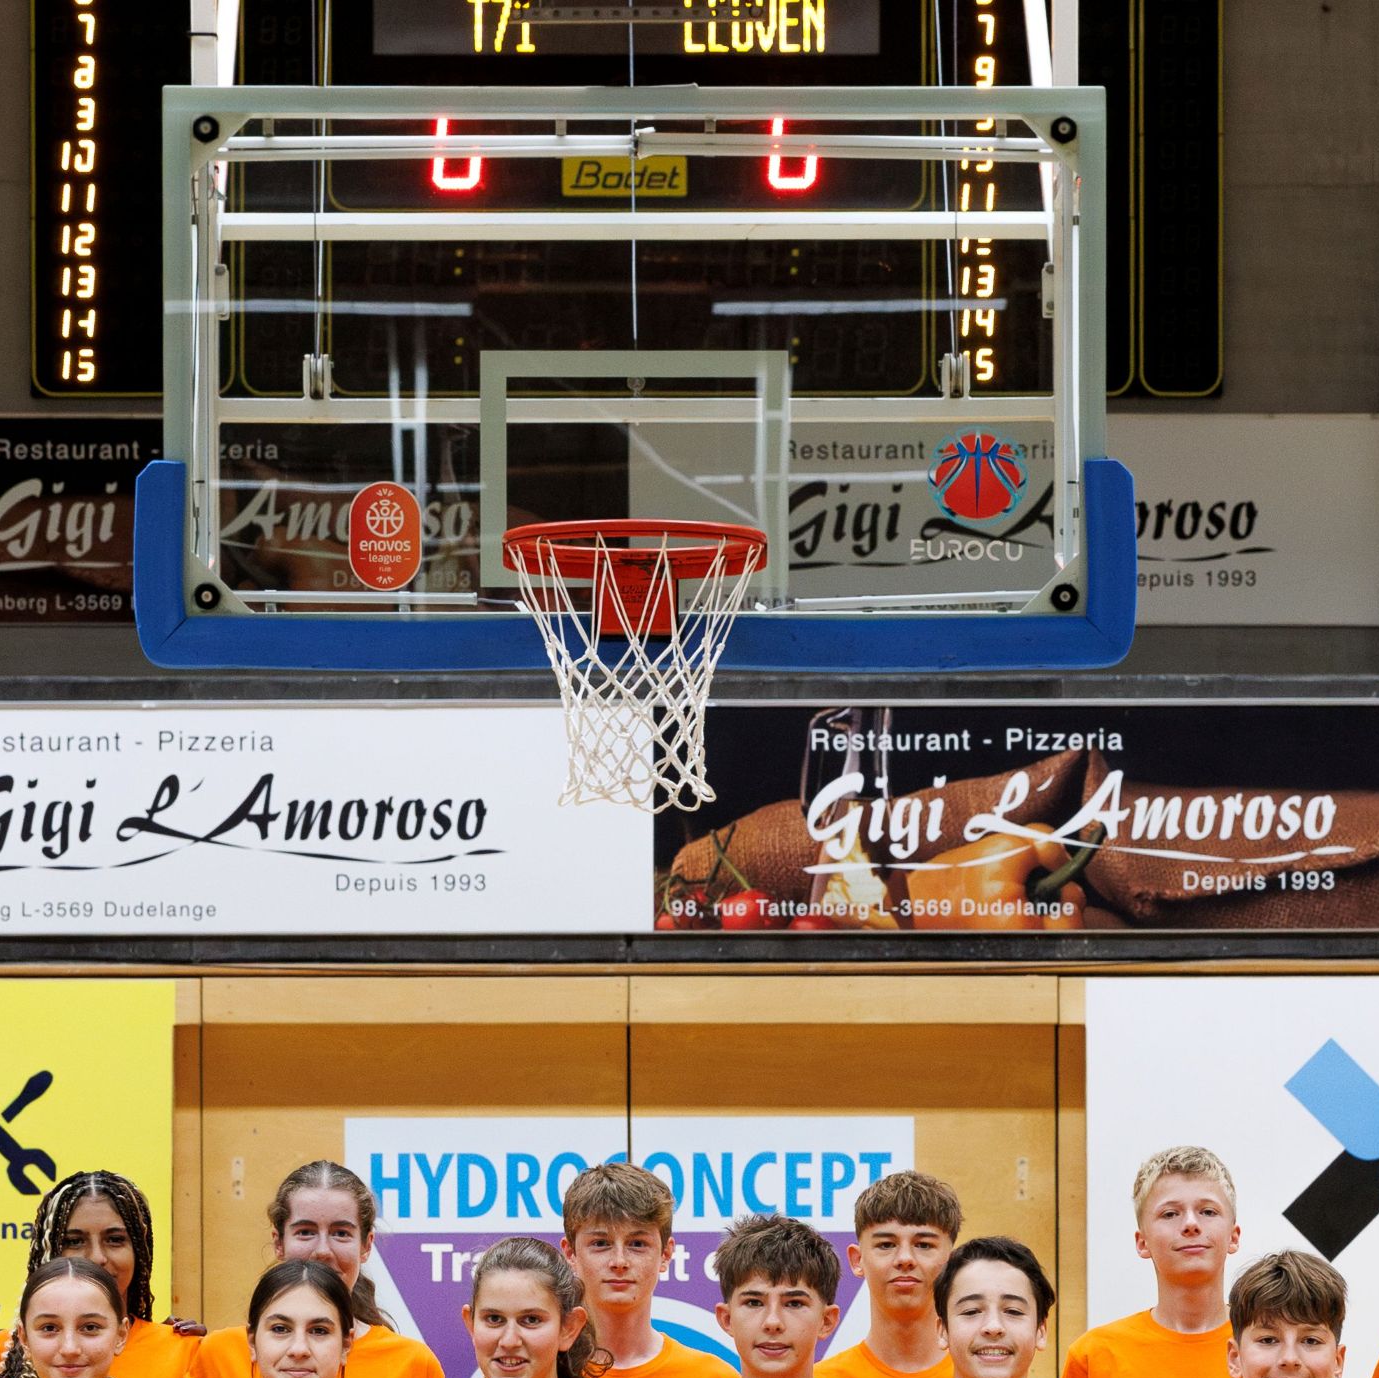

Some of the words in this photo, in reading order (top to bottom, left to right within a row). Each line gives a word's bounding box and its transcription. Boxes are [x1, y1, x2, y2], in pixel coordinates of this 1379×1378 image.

[978, 13, 995, 46] 7
[570, 158, 680, 190] Bodet
[61, 182, 96, 212] 11
[961, 182, 995, 211] 11
[61, 222, 96, 256] 12
[61, 264, 96, 299] 13
[961, 263, 995, 298] 13
[961, 307, 995, 338] 14
[61, 348, 96, 382] 15
[788, 481, 903, 558] Gigi
[359, 539, 412, 553] enovos
[368, 553, 403, 565] league
[910, 538, 1024, 562] EUROCU
[1206, 570, 1257, 588] 1993
[55, 595, 123, 611] L-3569
[158, 731, 275, 753] Pizzeria
[810, 728, 971, 752] Restaurant
[1005, 728, 1124, 752] Pizzeria
[805, 772, 945, 861] Gigi
[335, 874, 418, 895] Depuis
[430, 874, 488, 893] 1993
[1182, 870, 1266, 893] Depuis
[1276, 870, 1336, 890] 1993
[21, 901, 95, 919] L-3569
[103, 900, 218, 923] Dudelange
[670, 898, 706, 920] 98,
[712, 903, 748, 917] rue
[755, 897, 870, 921] Tattenberg
[878, 897, 952, 917] L-3569
[960, 897, 1075, 921] Dudelange
[369, 1152, 894, 1219] HYDROONCEPT
